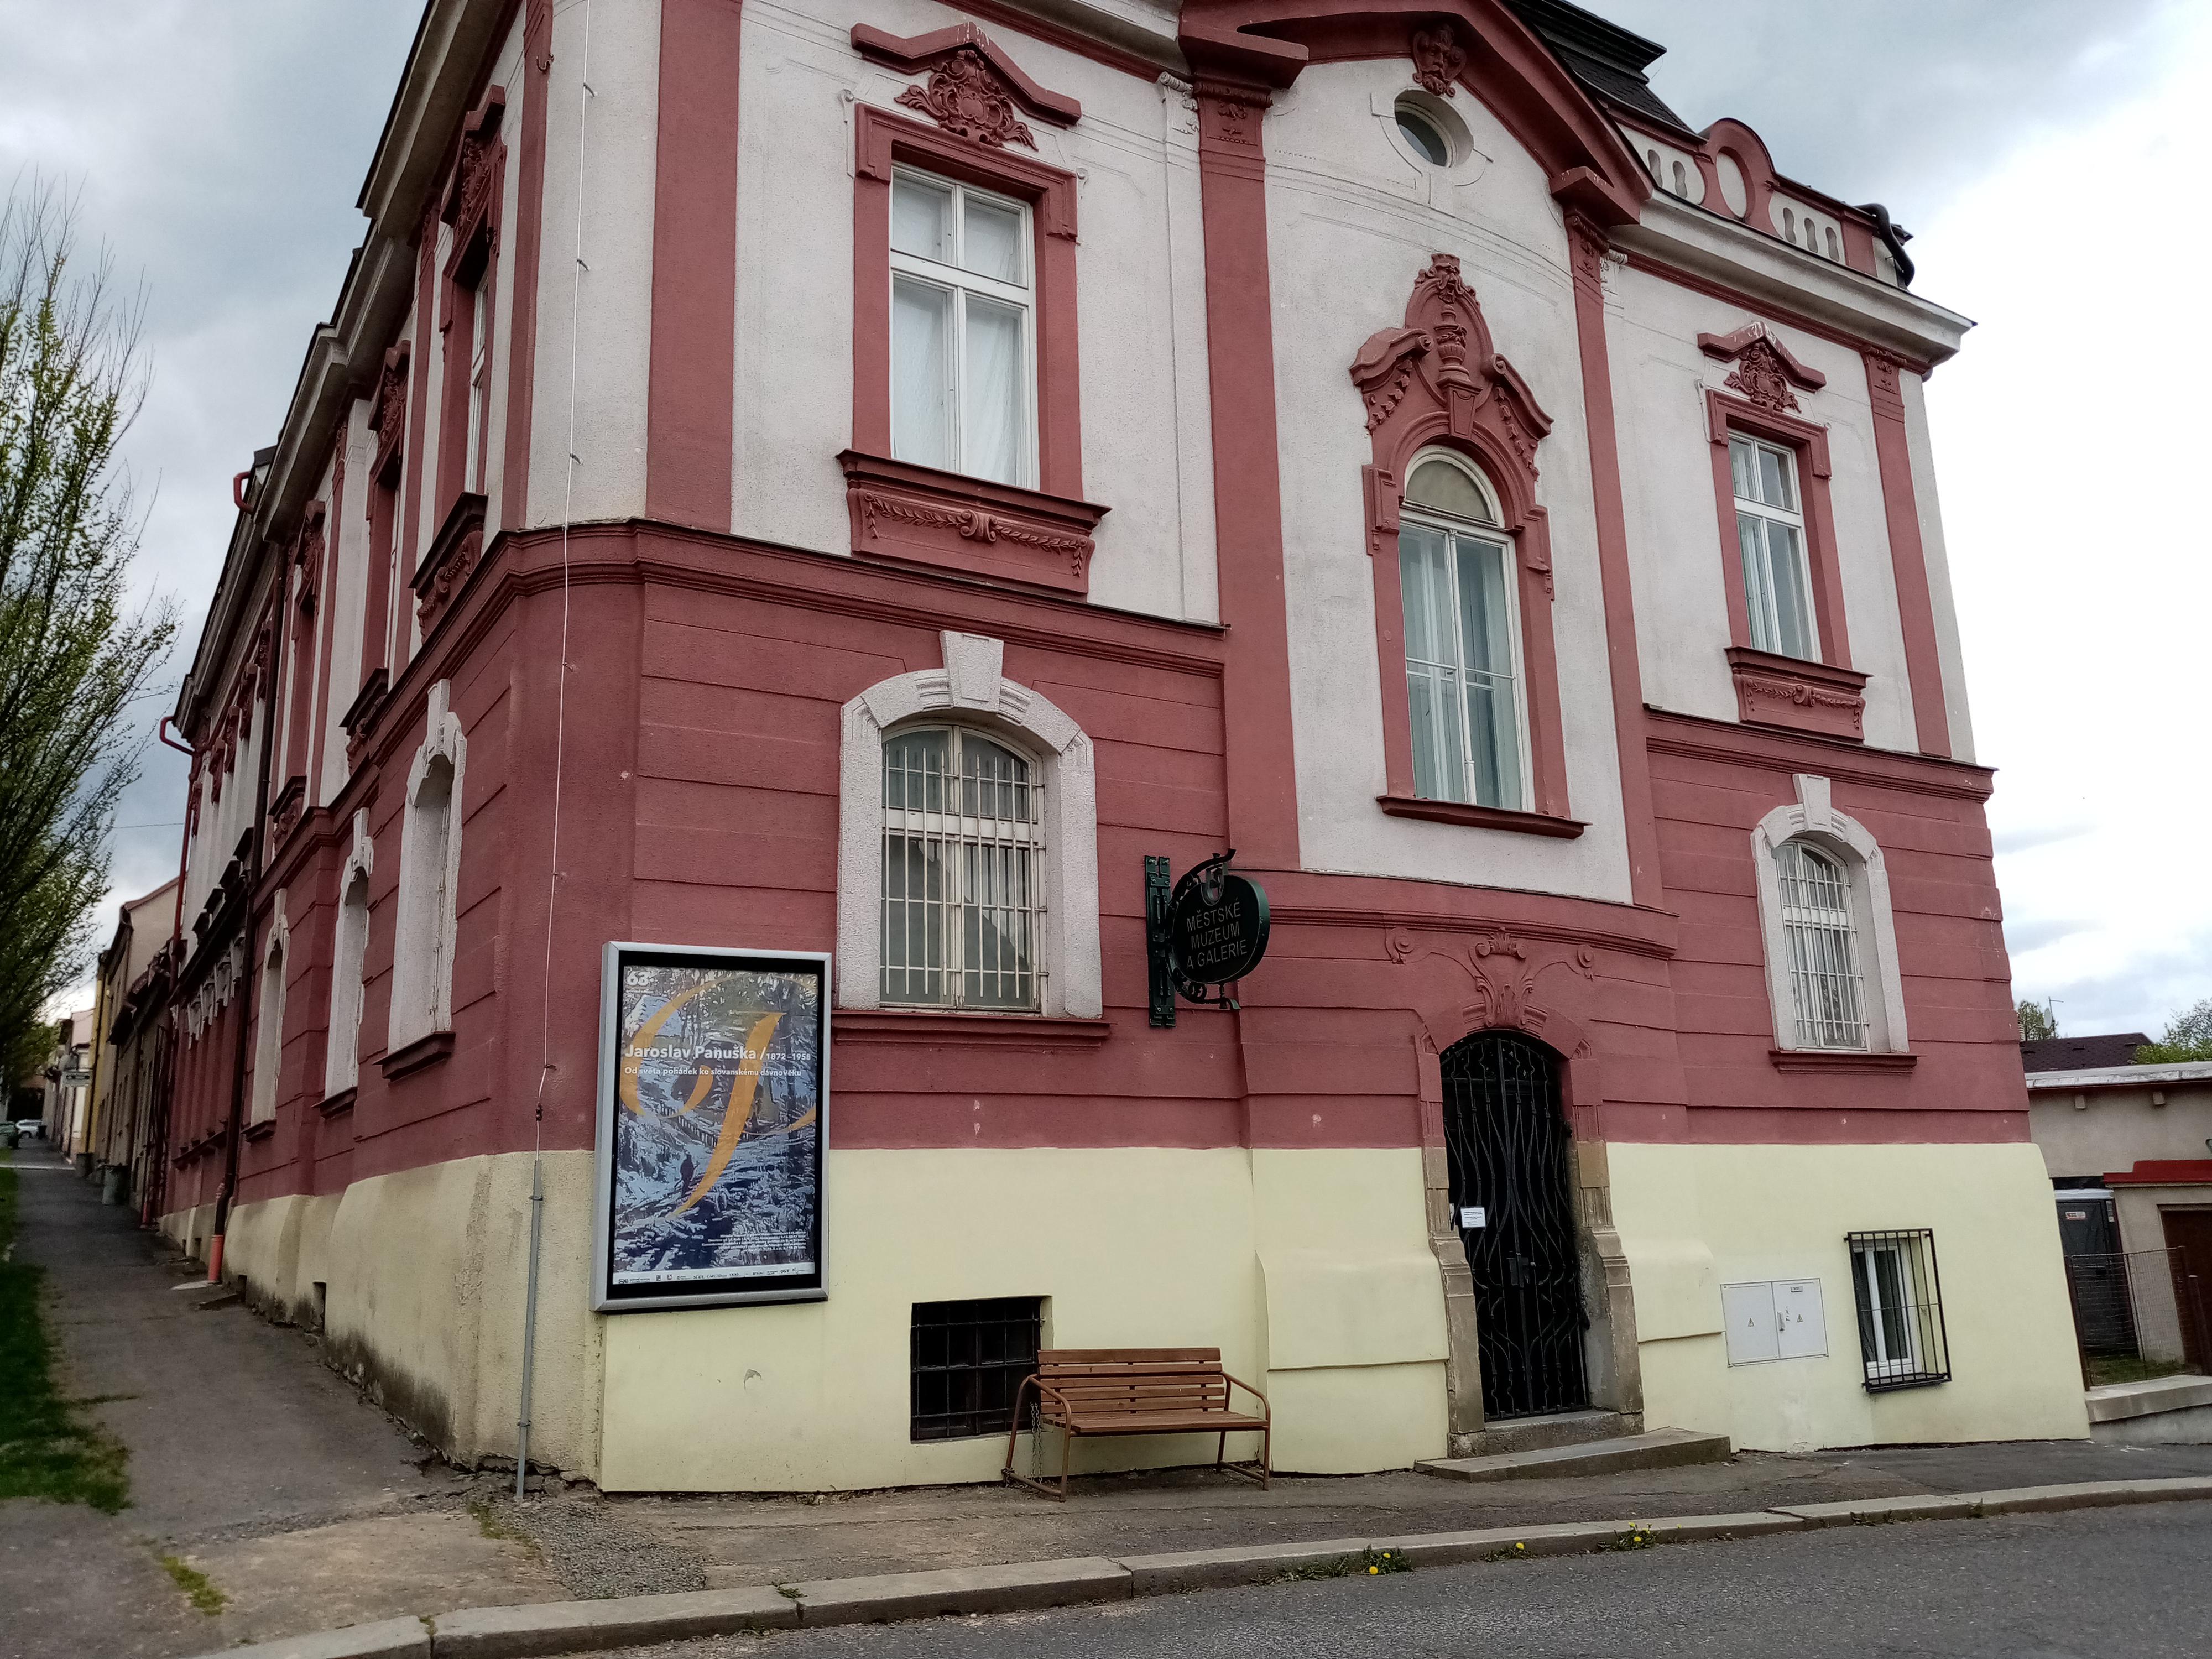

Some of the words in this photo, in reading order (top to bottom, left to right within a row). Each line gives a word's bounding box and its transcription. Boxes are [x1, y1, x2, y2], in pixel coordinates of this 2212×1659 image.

[1187, 896, 1241, 932] MĚSTSKÉ
[1191, 921, 1240, 950] MUZEUM
[1187, 956, 1194, 969] A
[1197, 939, 1248, 967] GALERIE
[624, 1044, 691, 1058] Jaroslav
[693, 1043, 757, 1060] Panuška
[663, 1067, 698, 1076] pohádek
